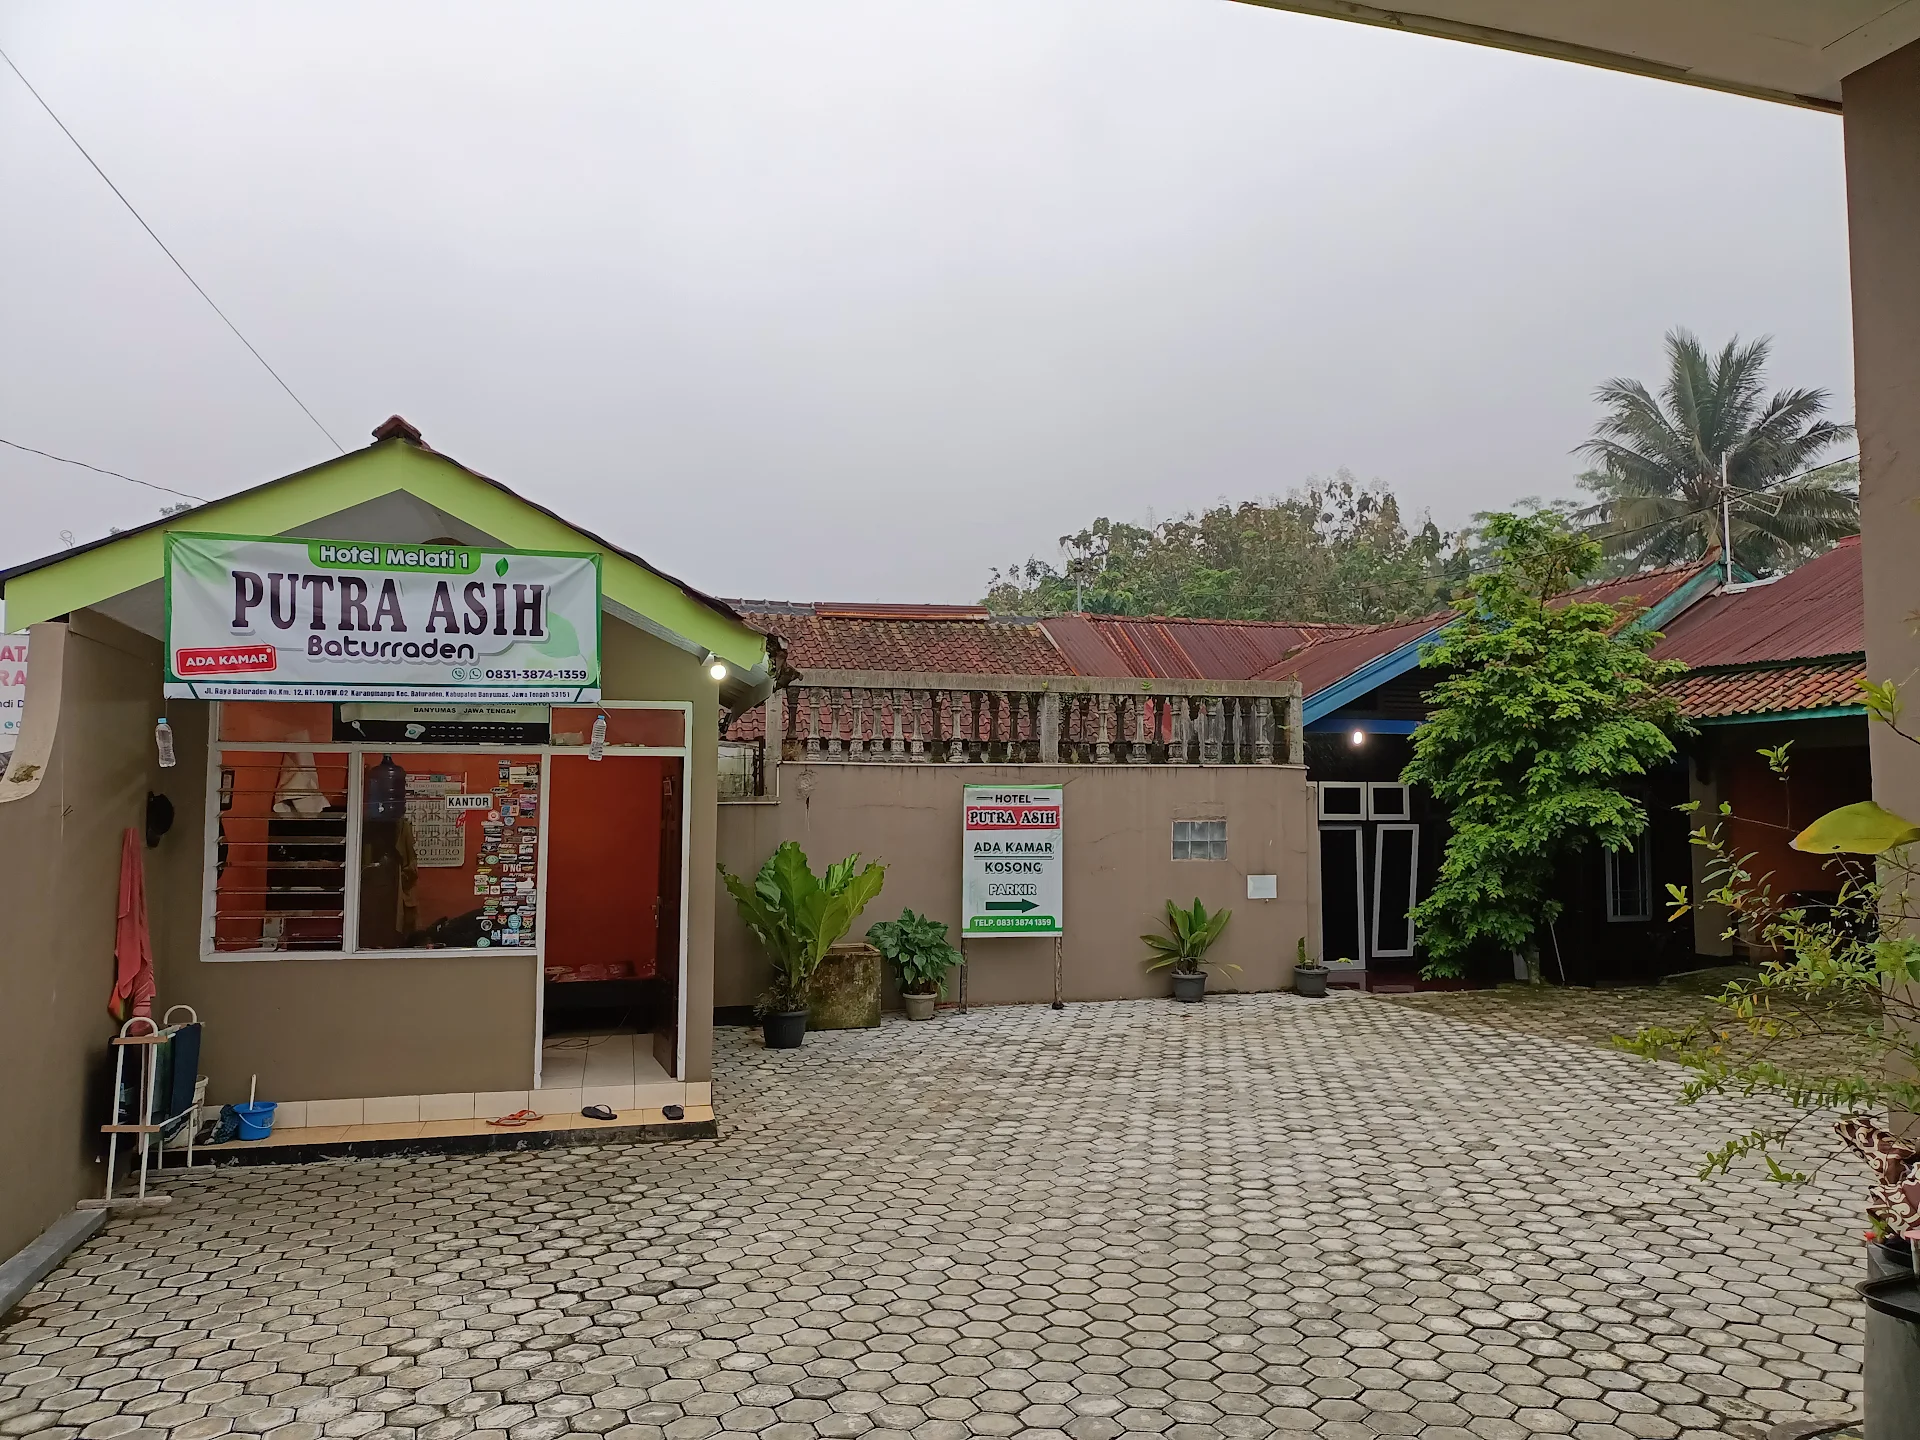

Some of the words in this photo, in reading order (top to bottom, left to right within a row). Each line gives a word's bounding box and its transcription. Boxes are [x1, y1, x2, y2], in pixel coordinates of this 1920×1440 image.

[320, 545, 380, 564] Hotel
[386, 549, 455, 568] Melati
[459, 553, 469, 569] 1
[231, 570, 408, 634] PUTRA
[425, 580, 545, 637] ASIH
[307, 634, 475, 661] Baturraden
[185, 656, 216, 667] ADA
[218, 653, 268, 665] KAMAR
[485, 669, 587, 680] 0831-3874-1359
[214, 687, 232, 696] Raya
[529, 691, 549, 699] Tengah
[448, 796, 489, 807] KANTOR
[995, 794, 1031, 804] HOTEL
[969, 811, 1015, 824] PUTRA
[1021, 812, 1056, 824] ASIH
[974, 842, 1001, 852] ADA
[1006, 842, 1053, 853] KAMAR
[984, 862, 1042, 873] KOSONG
[988, 883, 1038, 896] PARKIR
[974, 919, 995, 927] TELP.
[996, 919, 1013, 927] 0831
[1015, 919, 1033, 927] 3874
